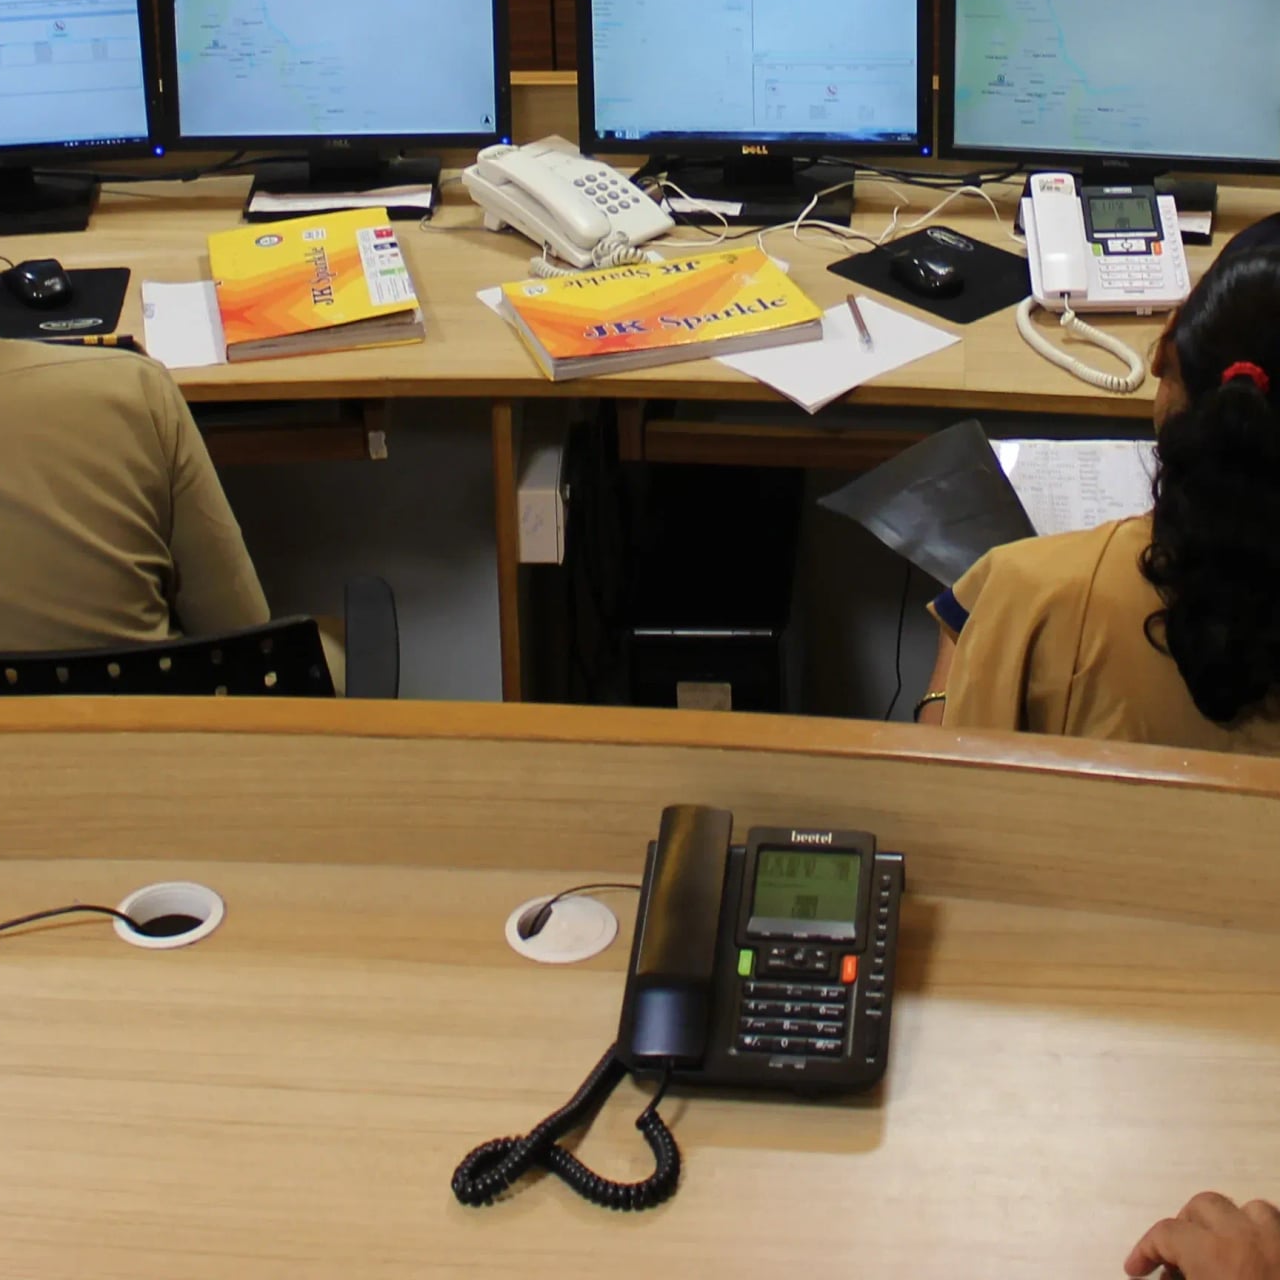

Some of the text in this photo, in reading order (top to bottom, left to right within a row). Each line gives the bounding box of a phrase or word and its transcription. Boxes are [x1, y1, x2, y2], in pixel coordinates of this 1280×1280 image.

[741, 143, 769, 155] DELL
[661, 261, 701, 276] JK
[312, 285, 334, 305] JK
[584, 296, 788, 340] JK Sparkle
[791, 829, 833, 845] beetel
